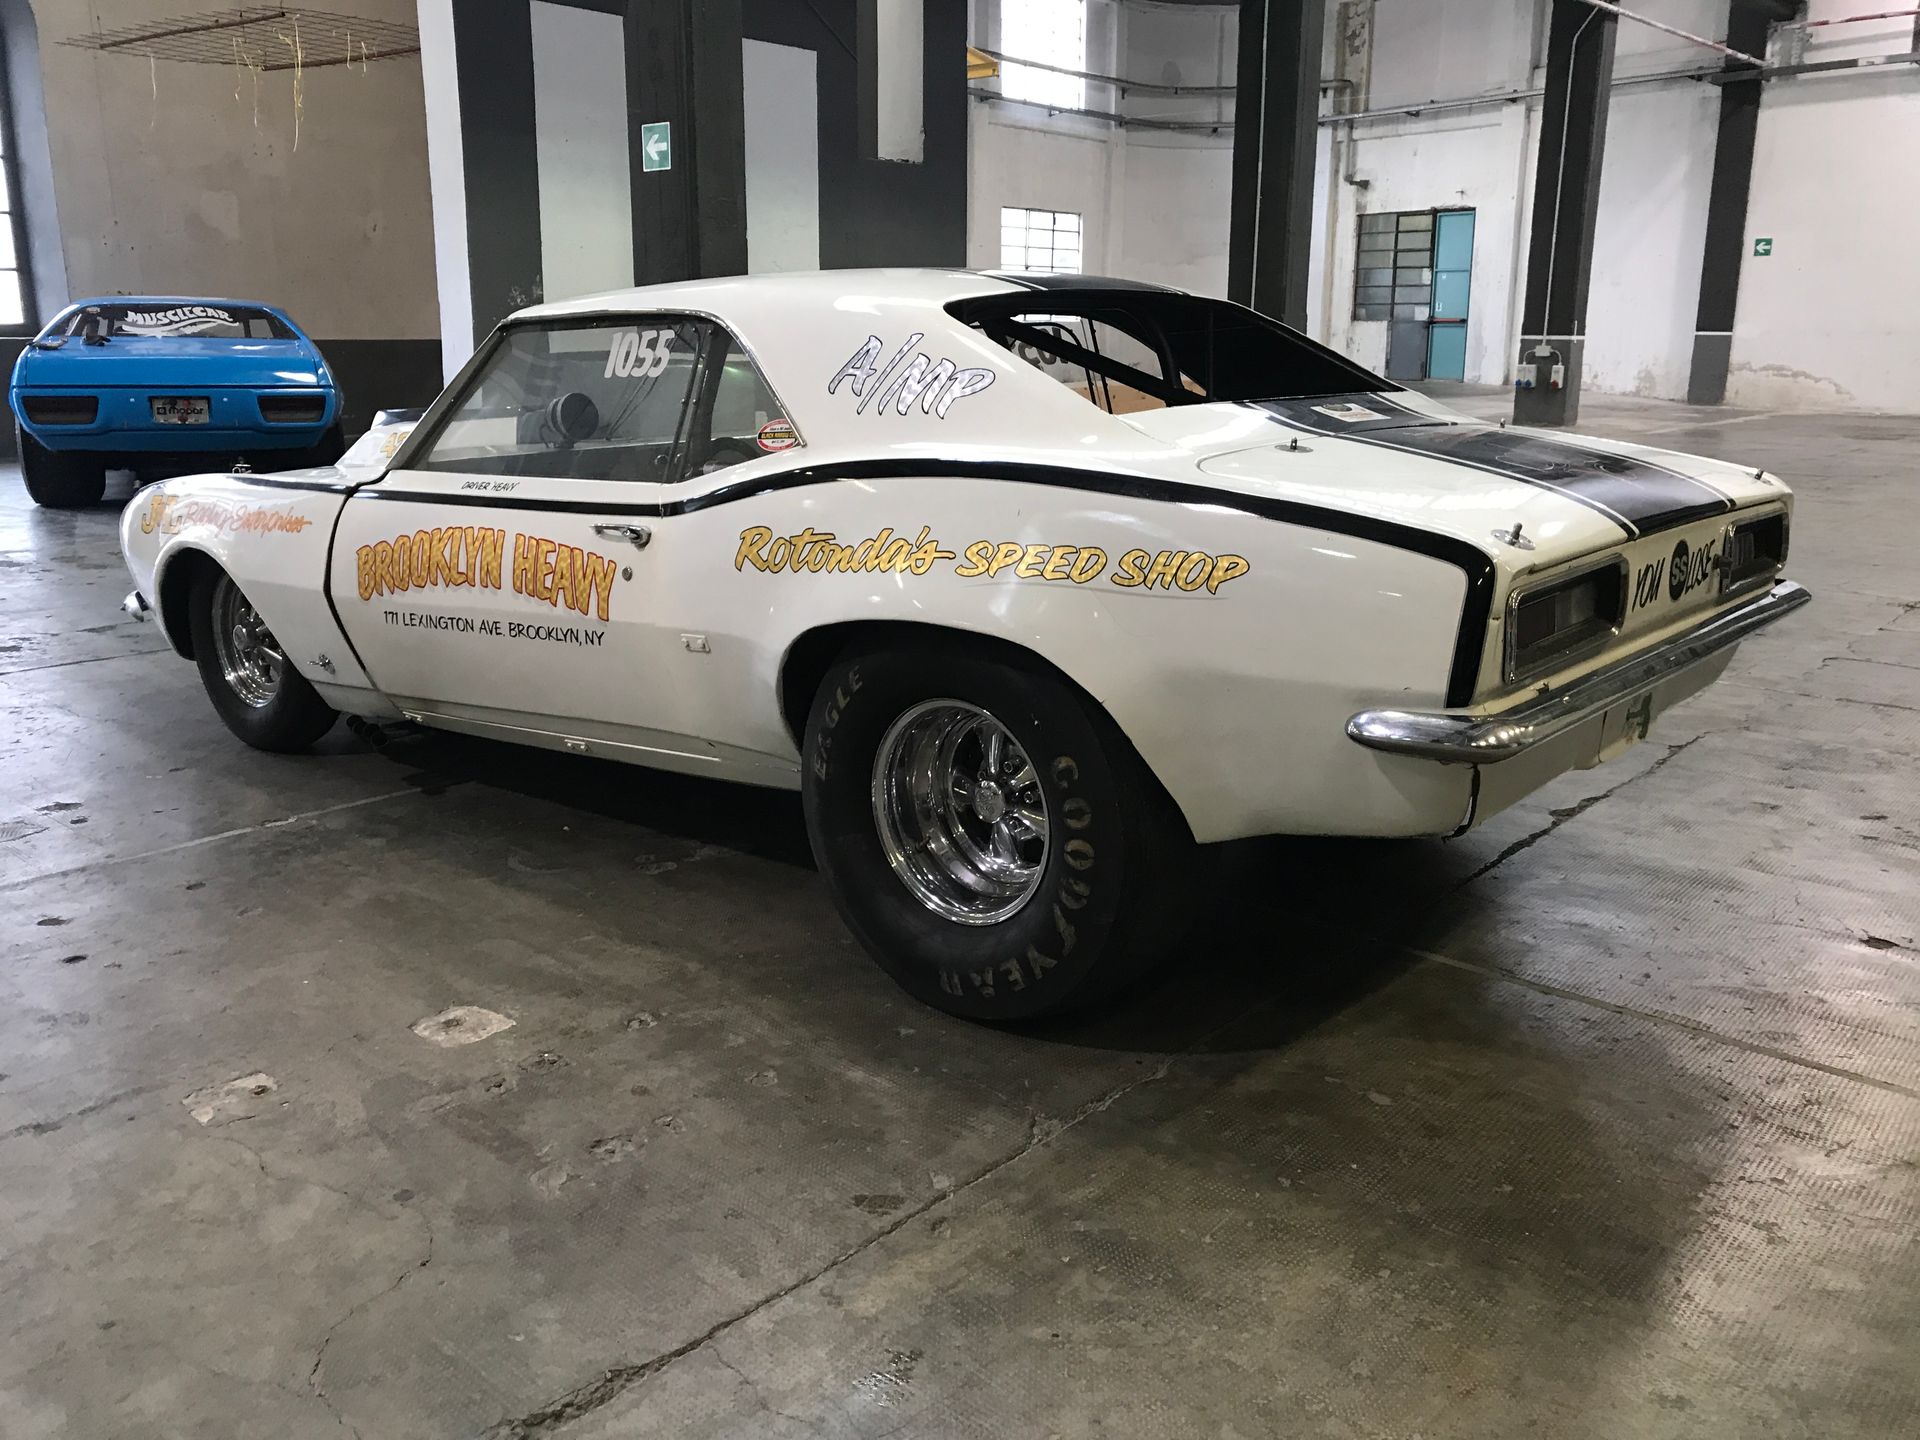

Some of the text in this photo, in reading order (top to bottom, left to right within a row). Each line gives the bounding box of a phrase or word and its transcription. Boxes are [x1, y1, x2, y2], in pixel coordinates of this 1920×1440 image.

[124, 306, 234, 325] MUSCLECAR
[604, 330, 675, 379] 1055
[828, 333, 996, 420] A/MP
[461, 481, 490, 491] DRIVER
[356, 526, 617, 622] BROOKLYN HEAVY
[735, 525, 1251, 595] Rotonda's SPEED SHOP
[1632, 557, 1666, 613] YOU
[383, 611, 605, 647] 171 LEXINGTON AVE. BROOKLYN, NY
[812, 665, 863, 781] EAGLE
